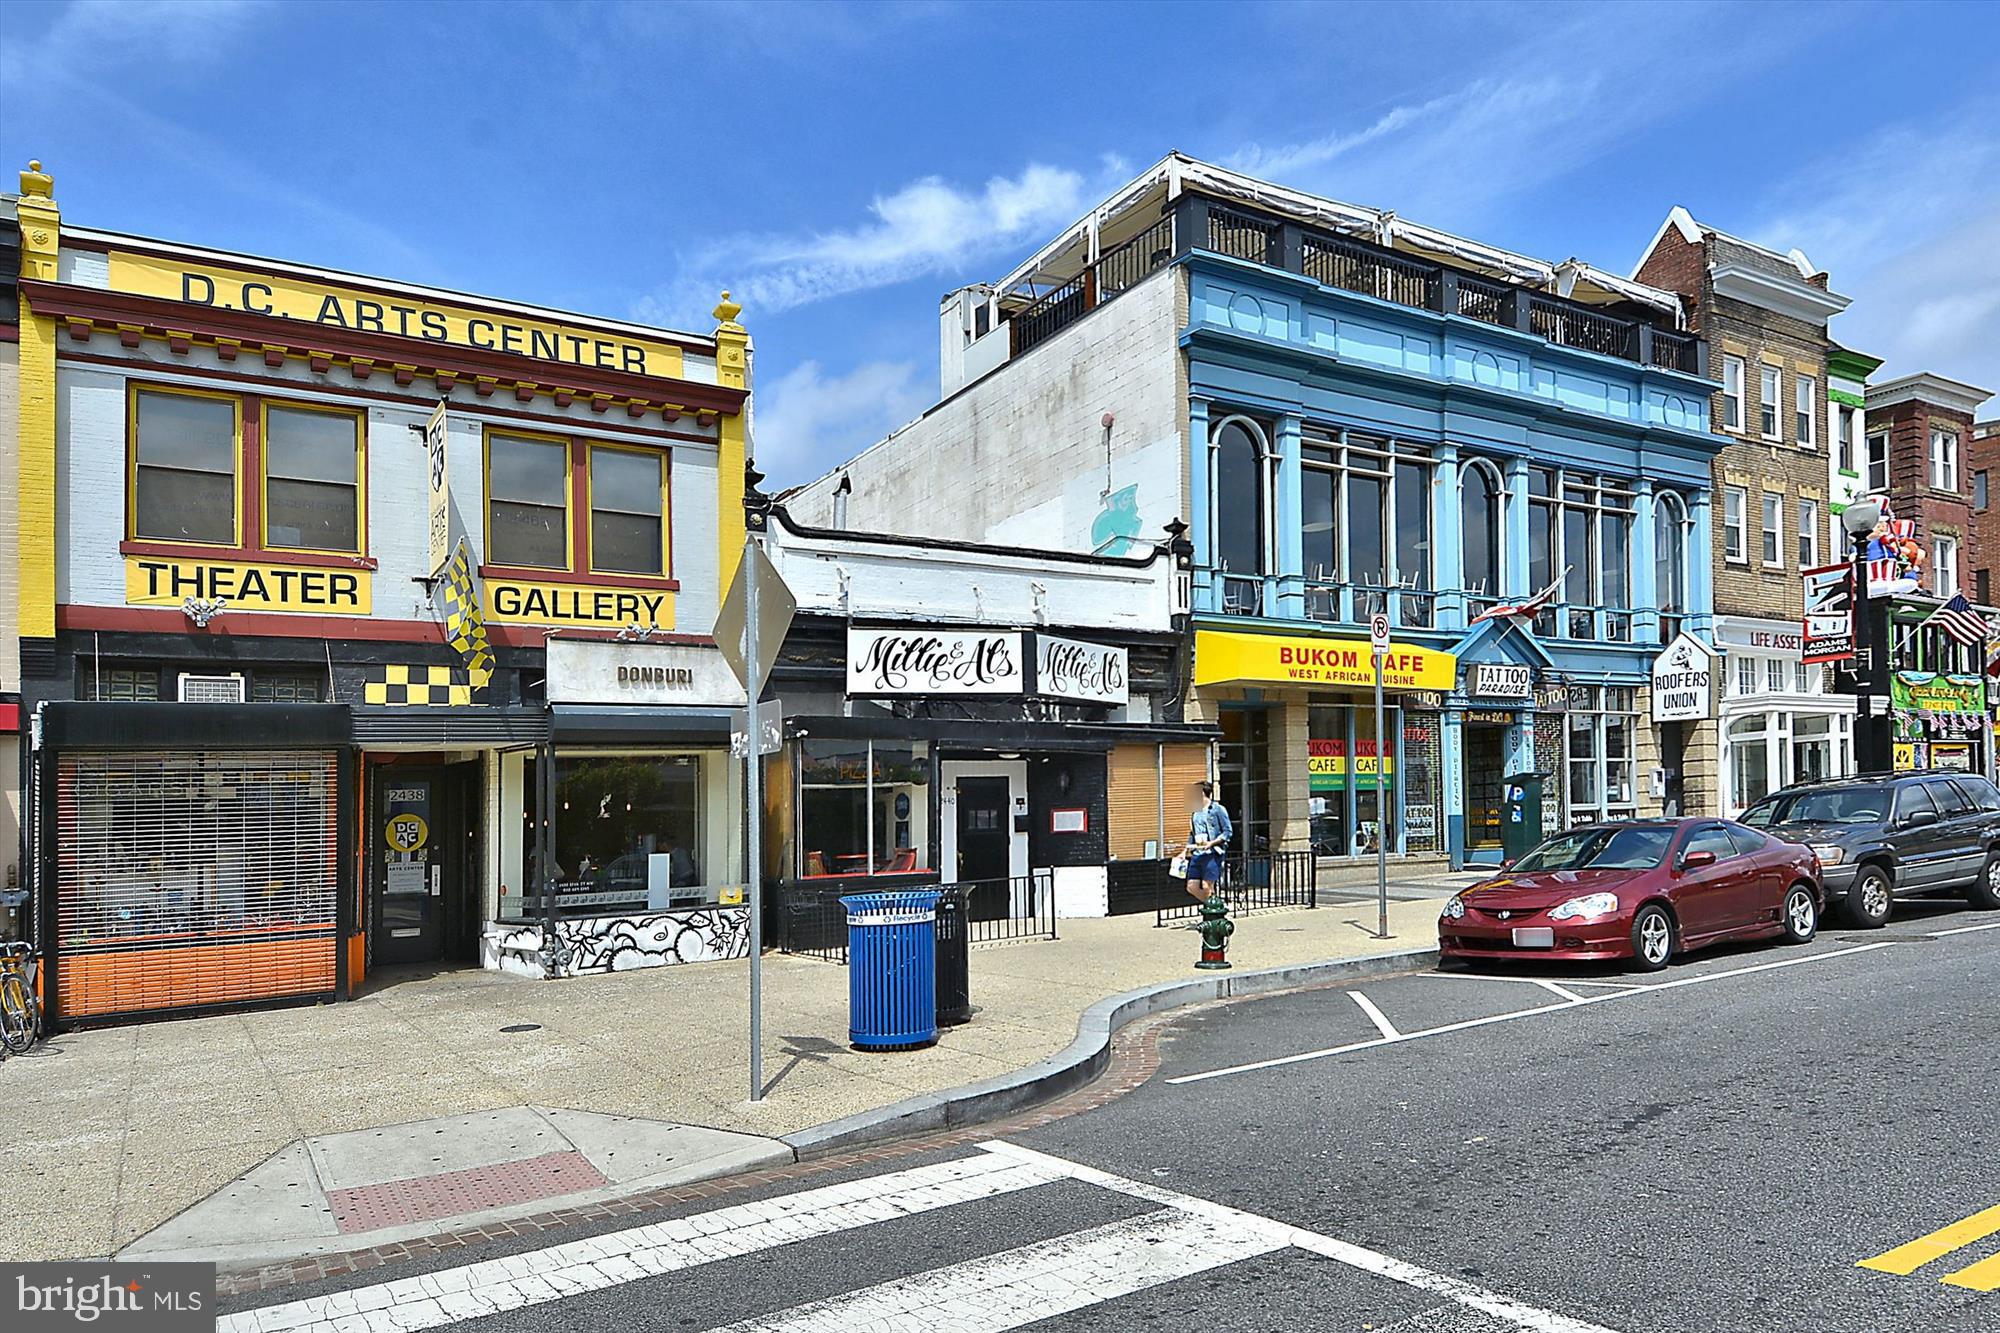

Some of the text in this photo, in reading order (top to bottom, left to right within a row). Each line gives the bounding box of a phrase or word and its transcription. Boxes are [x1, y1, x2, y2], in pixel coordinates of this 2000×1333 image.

[181, 272, 648, 375] D.C. ARTS CENTER
[137, 562, 359, 606] THEATER
[493, 584, 665, 623] GALLERY
[1750, 631, 1771, 647] LIFE
[1808, 638, 1847, 649] ADAMS
[1280, 647, 1357, 668] BUKOM
[1803, 644, 1851, 656] MORGAN
[855, 635, 1018, 689] Millie & Al's
[1038, 641, 1089, 695] Millie
[617, 665, 694, 684] DONBURI
[1288, 669, 1415, 685] WEST AFRICAN UISINE
[1480, 667, 1528, 684] TATTOO
[1654, 671, 1709, 691] ROOFERS
[1478, 684, 1526, 695] PARADISE
[1663, 692, 1697, 709] UNION
[1309, 741, 1343, 755] UKOM
[1511, 730, 1519, 752] BODY
[1308, 758, 1336, 772] CAFE
[1356, 758, 1378, 772] CAF
[390, 790, 425, 801] 2438
[1405, 807, 1433, 818] ATTOO
[893, 914, 921, 922] Recycle
